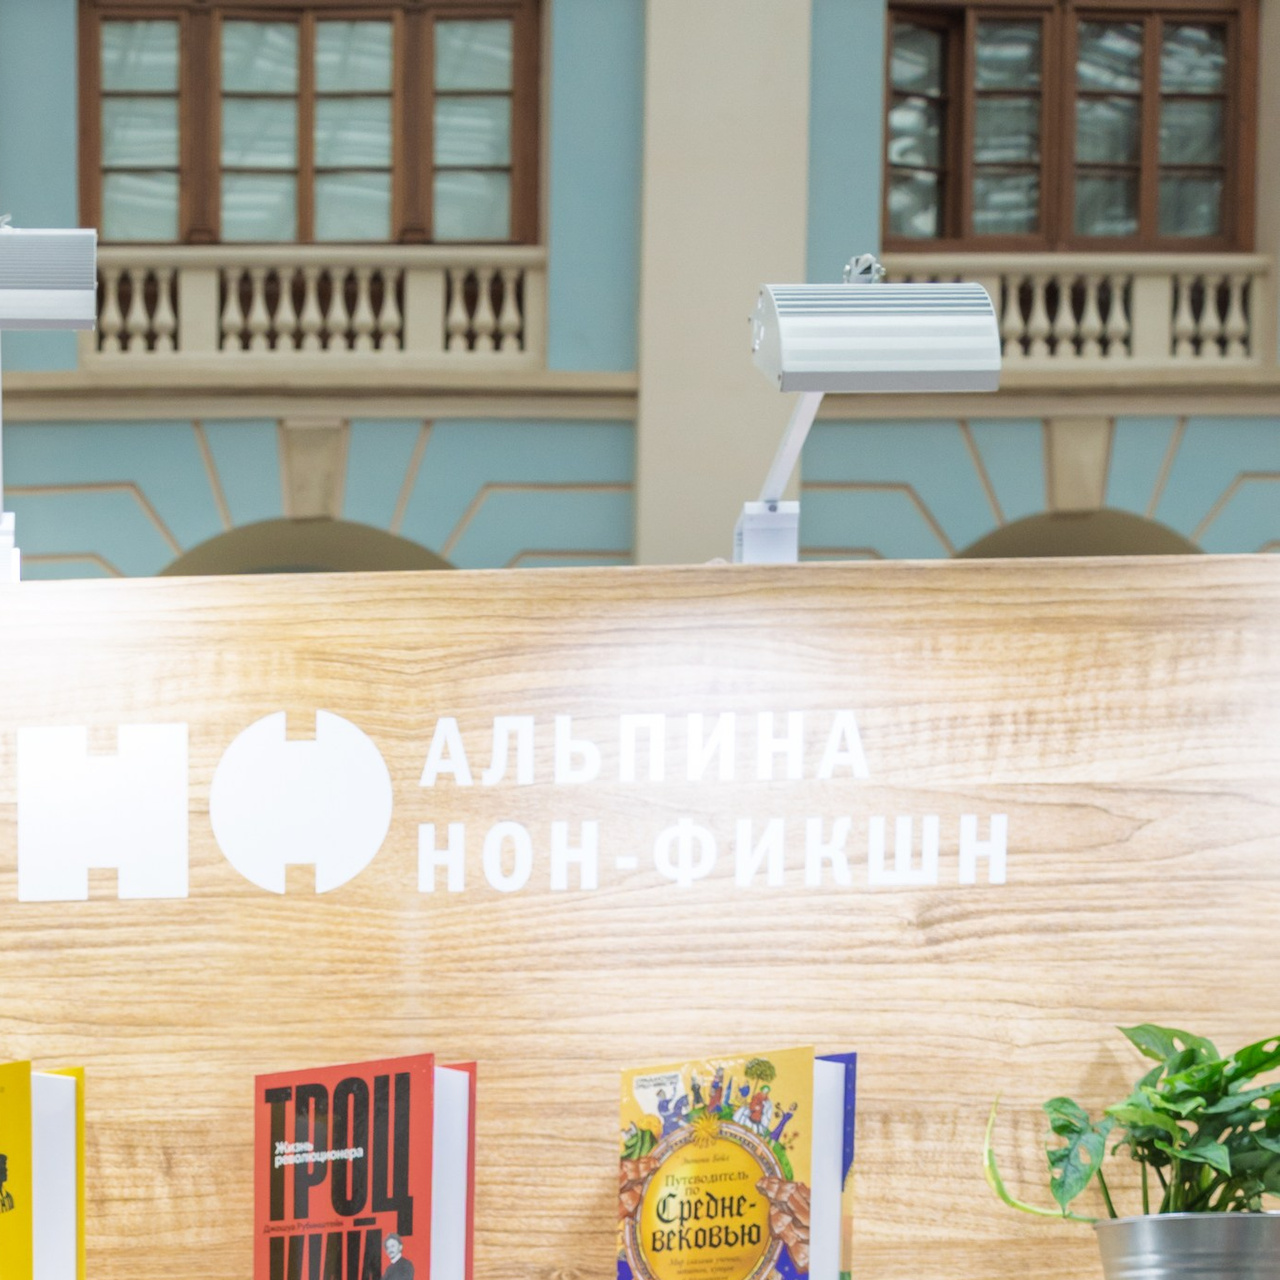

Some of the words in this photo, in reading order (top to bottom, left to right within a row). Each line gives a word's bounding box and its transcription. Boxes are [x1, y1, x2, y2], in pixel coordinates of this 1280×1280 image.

[418, 710, 870, 788] АЛЬПИНА
[418, 814, 1009, 893] НОН-ФИКШН
[264, 1071, 414, 1237] ТРОЦ
[274, 1147, 364, 1169] революционера
[664, 1170, 750, 1188] Путеводитель
[684, 1186, 701, 1198] по
[656, 1191, 757, 1226] Средне-
[651, 1222, 761, 1253] вековью
